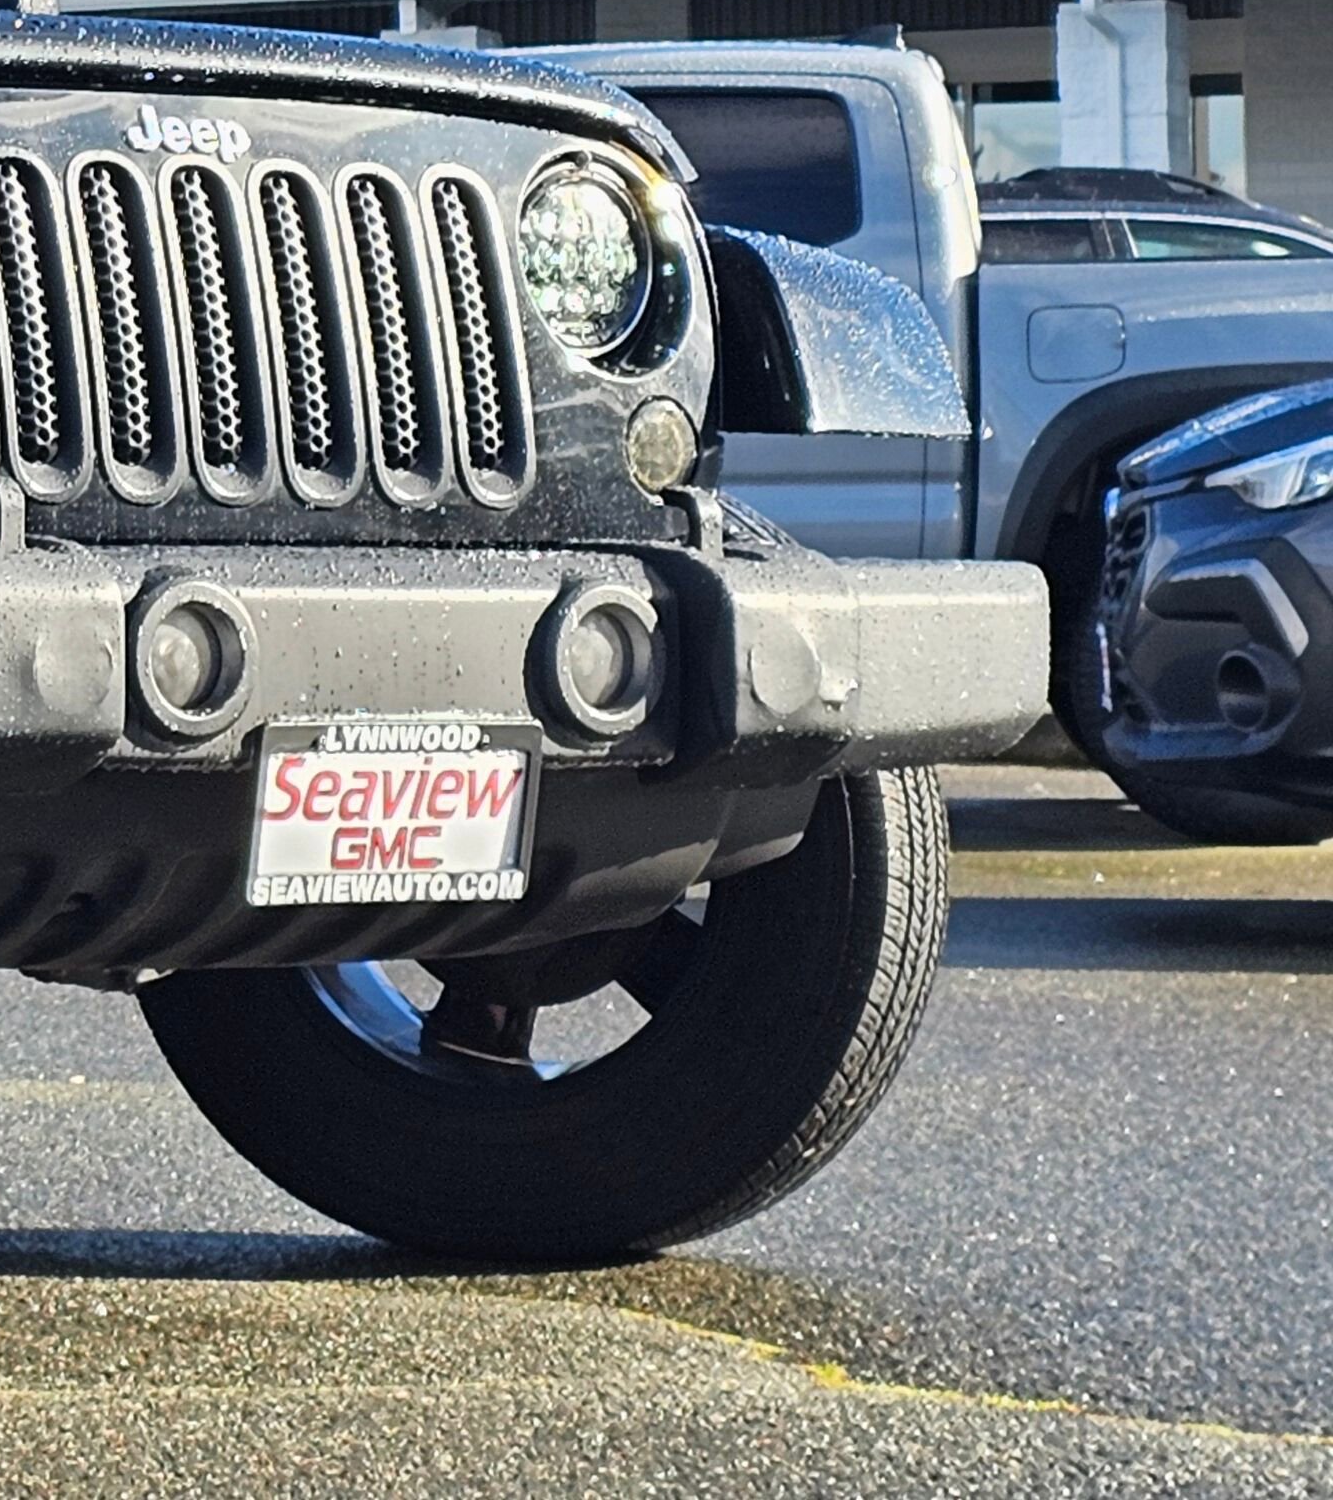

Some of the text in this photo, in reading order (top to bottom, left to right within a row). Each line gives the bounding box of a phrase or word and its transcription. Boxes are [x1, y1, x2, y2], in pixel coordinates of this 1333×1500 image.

[126, 104, 252, 164] Jeep
[326, 725, 482, 751] LYNNWOOD
[262, 756, 523, 821] Seaview
[330, 825, 443, 870] GMC
[251, 871, 525, 905] SEAVIEWAUTO.COM
